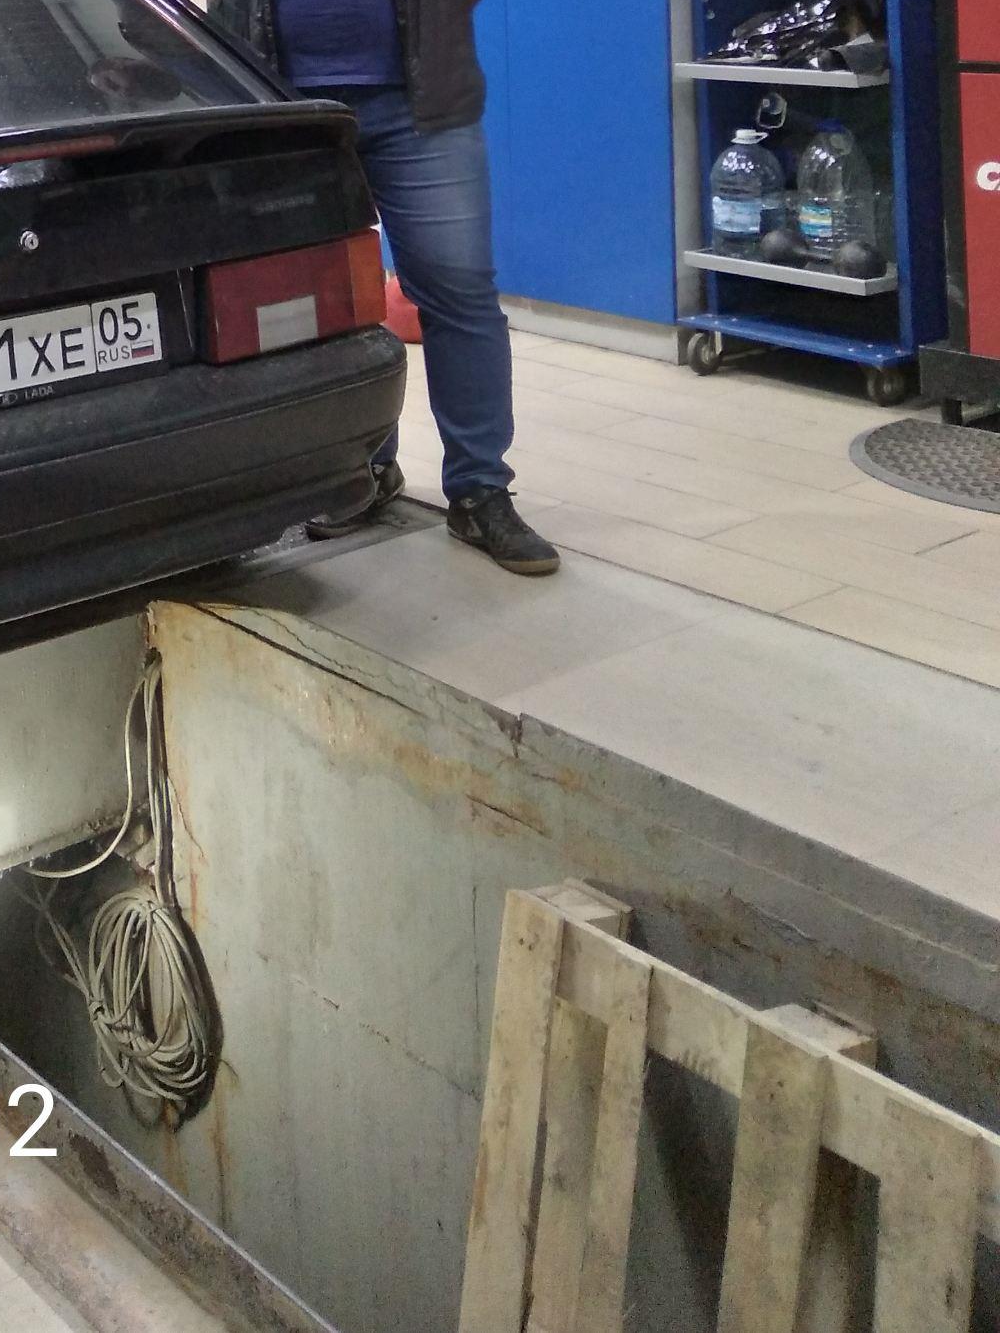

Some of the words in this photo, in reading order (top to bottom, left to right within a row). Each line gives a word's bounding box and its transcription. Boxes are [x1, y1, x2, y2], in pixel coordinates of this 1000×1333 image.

[99, 301, 143, 346] 05
[97, 346, 131, 364] RUS
[24, 385, 54, 400] LADA
